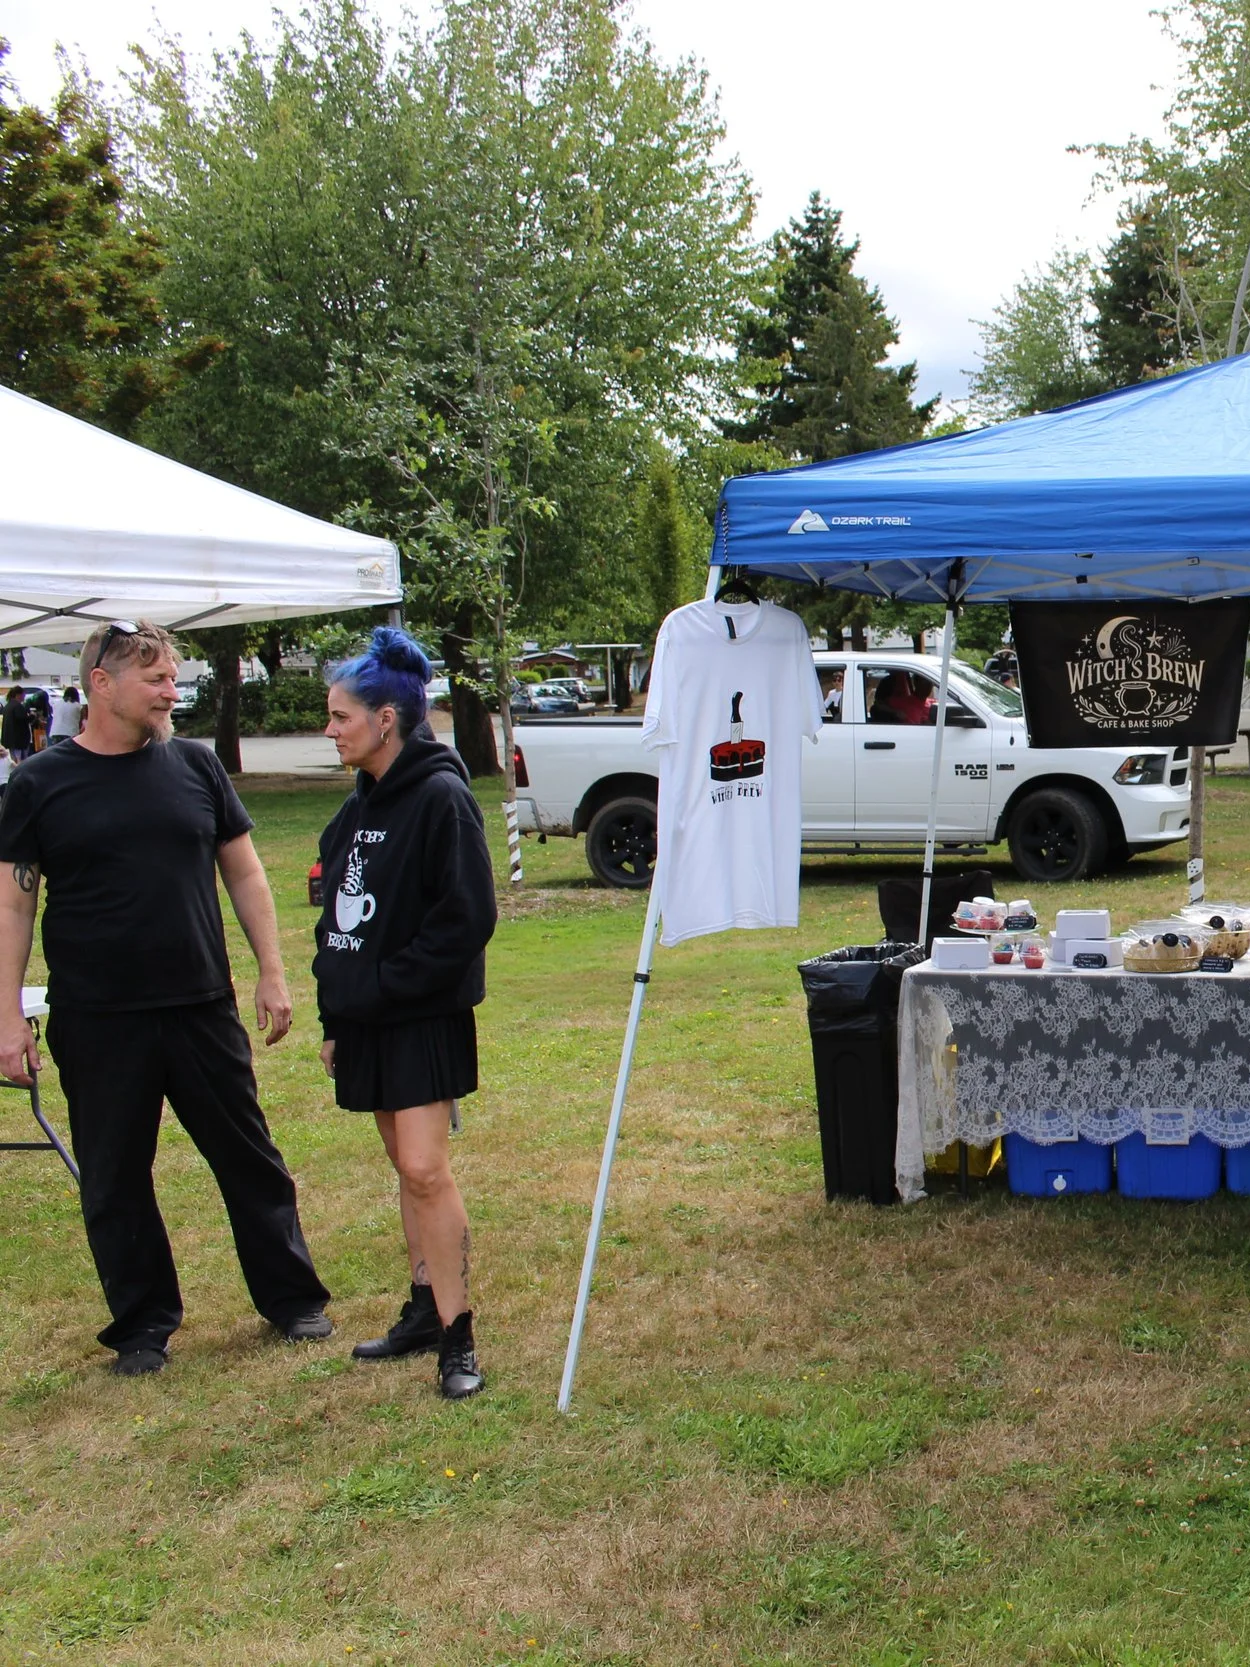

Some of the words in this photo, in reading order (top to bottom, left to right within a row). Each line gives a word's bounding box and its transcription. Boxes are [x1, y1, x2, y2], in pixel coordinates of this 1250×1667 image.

[1146, 652, 1206, 692] BREW
[1097, 720, 1118, 729] CAFE
[1120, 720, 1126, 728] &
[1128, 720, 1150, 729] BAKE
[1152, 719, 1174, 728] SHOP
[327, 932, 365, 951] BREW
